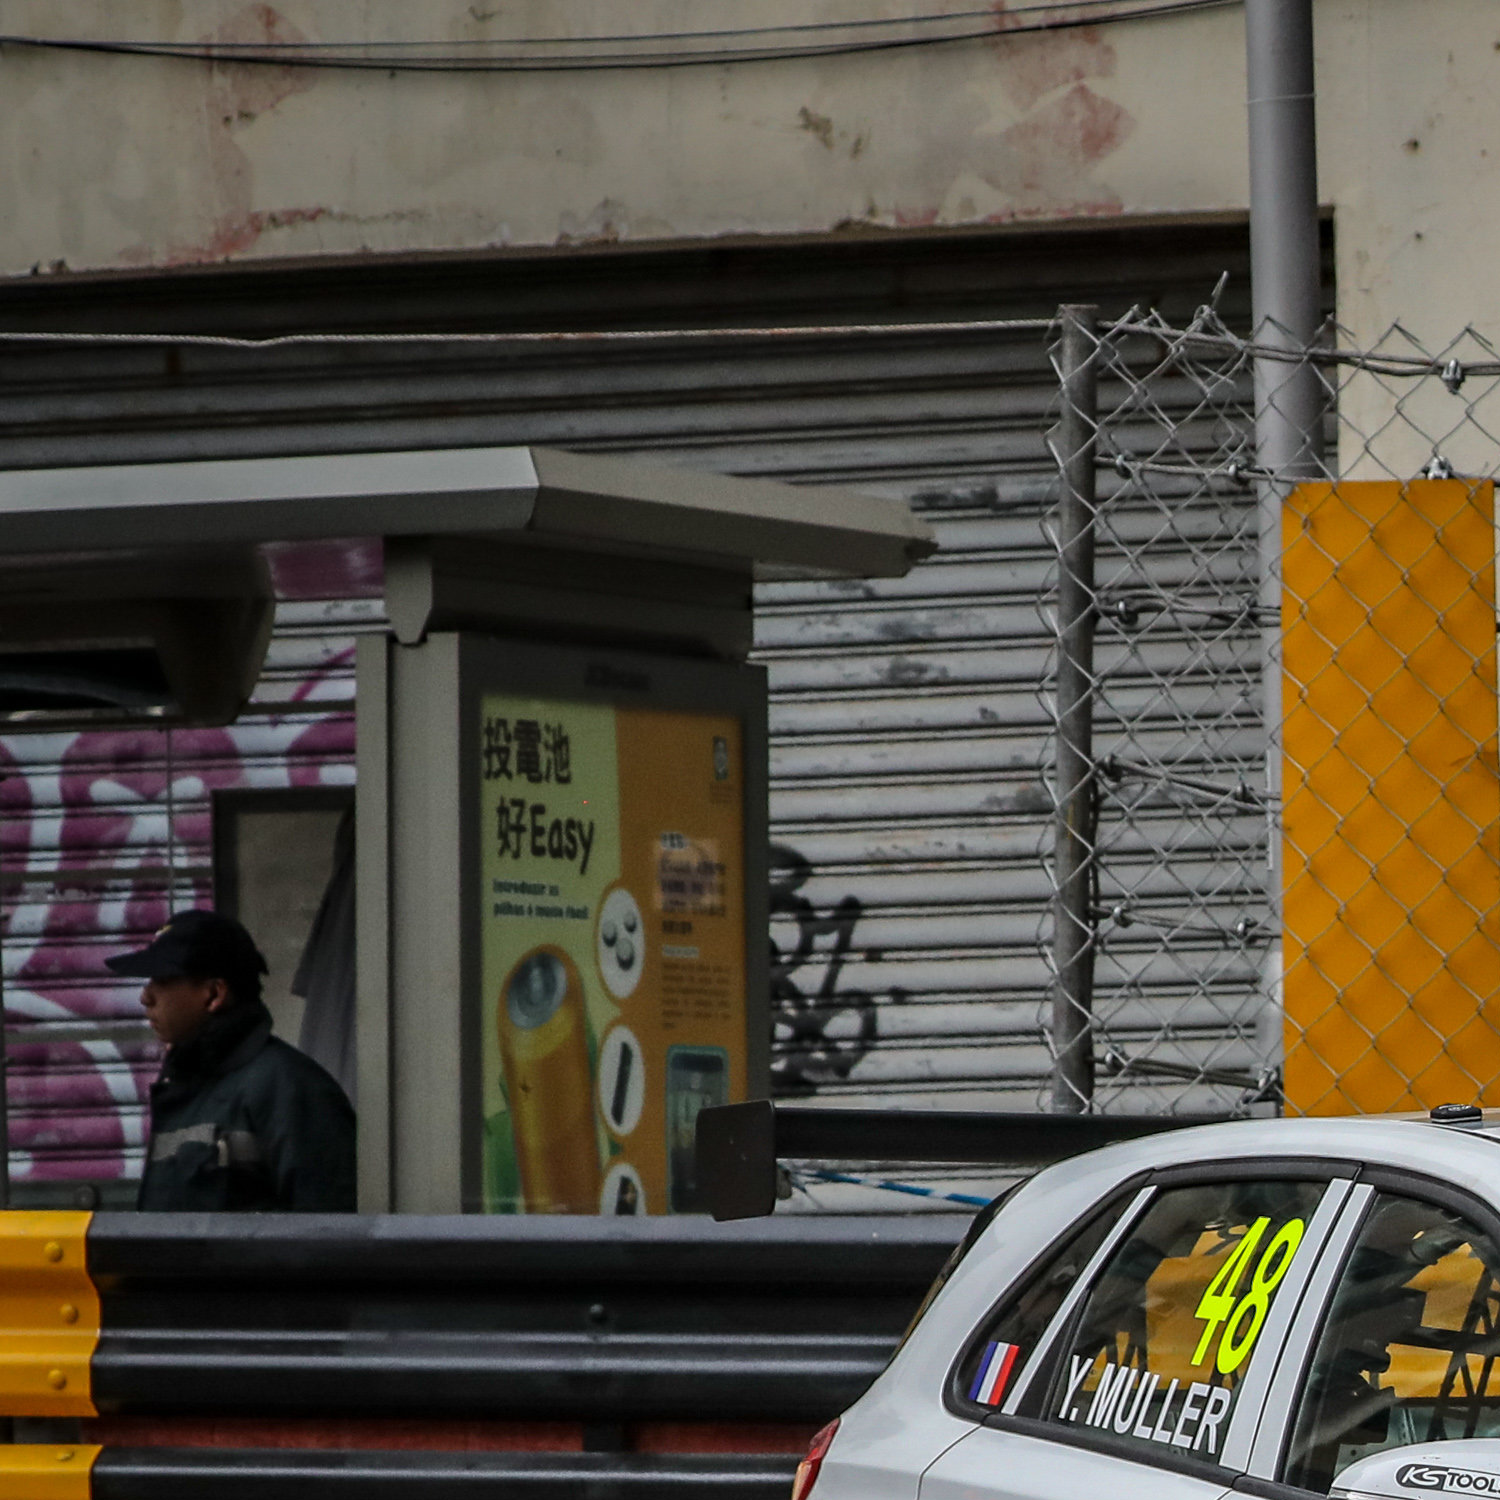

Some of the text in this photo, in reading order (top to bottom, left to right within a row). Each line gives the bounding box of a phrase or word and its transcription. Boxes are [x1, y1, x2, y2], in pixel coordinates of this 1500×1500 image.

[484, 717, 571, 785] 投電池
[1190, 1216, 1306, 1376] 48
[1057, 1354, 1233, 1455] Y. MULLER
[1401, 1466, 1448, 1487] KS
